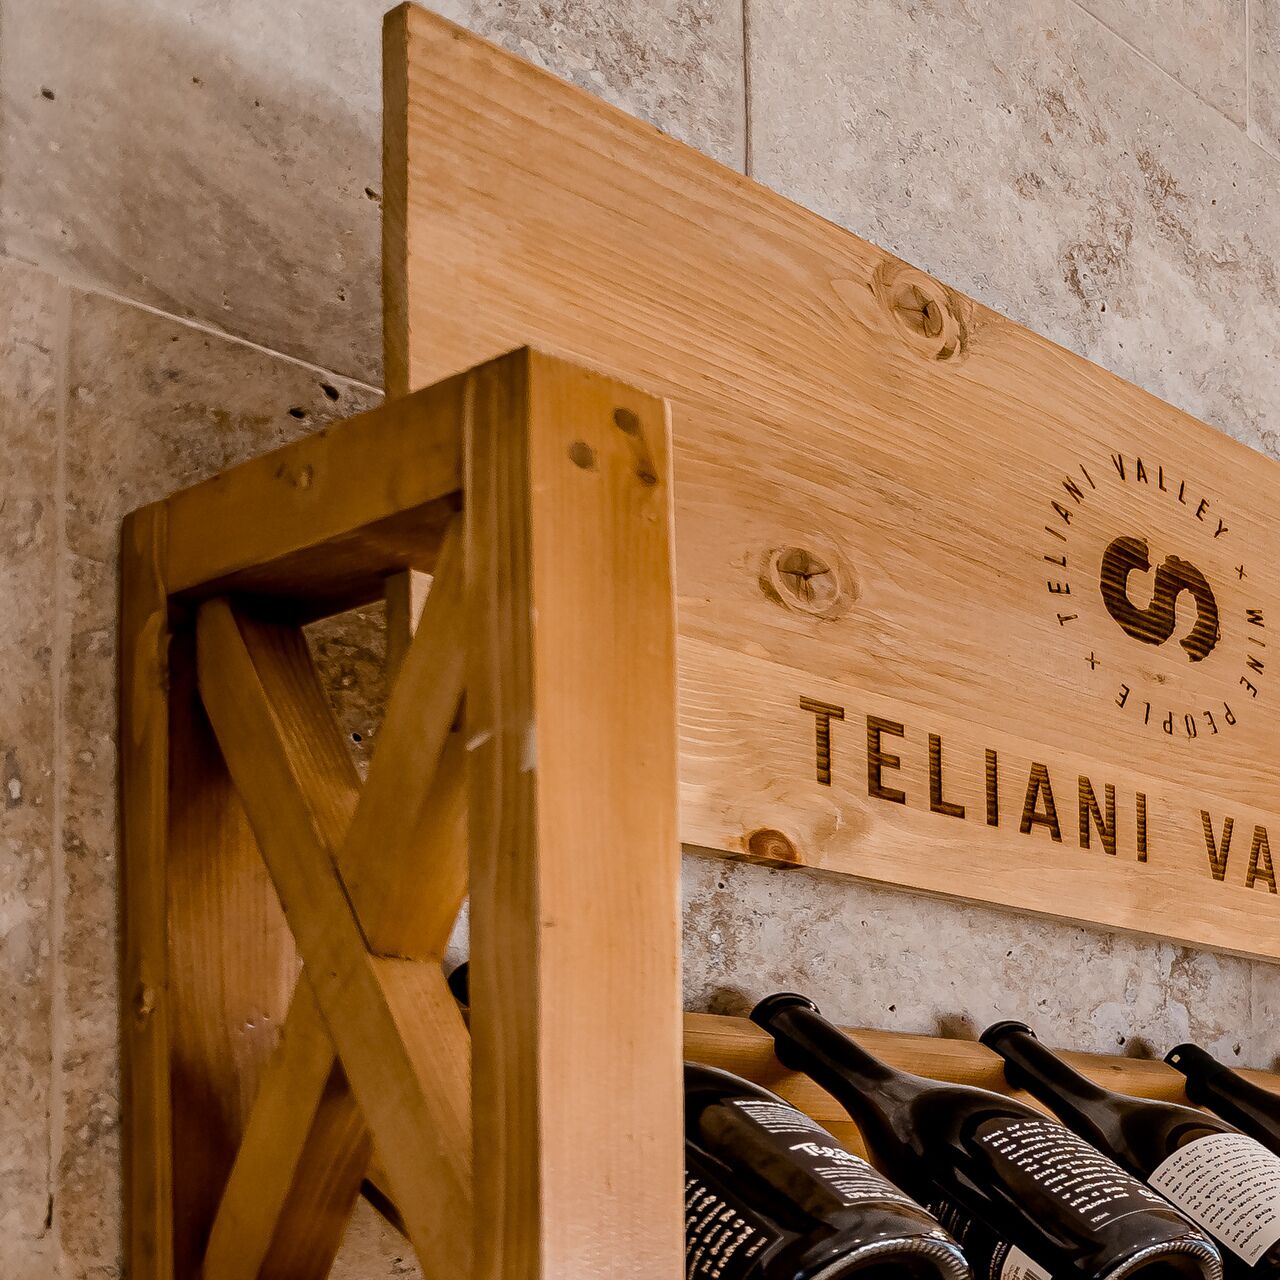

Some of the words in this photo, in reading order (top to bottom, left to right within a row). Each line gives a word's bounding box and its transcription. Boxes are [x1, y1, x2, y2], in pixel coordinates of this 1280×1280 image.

[1044, 464, 1096, 627] TELIANI
[1110, 453, 1229, 539] VALLEY
[1114, 683, 1238, 739] PEOPLE
[1239, 608, 1266, 698] WINE
[799, 695, 1150, 862] TELIANI
